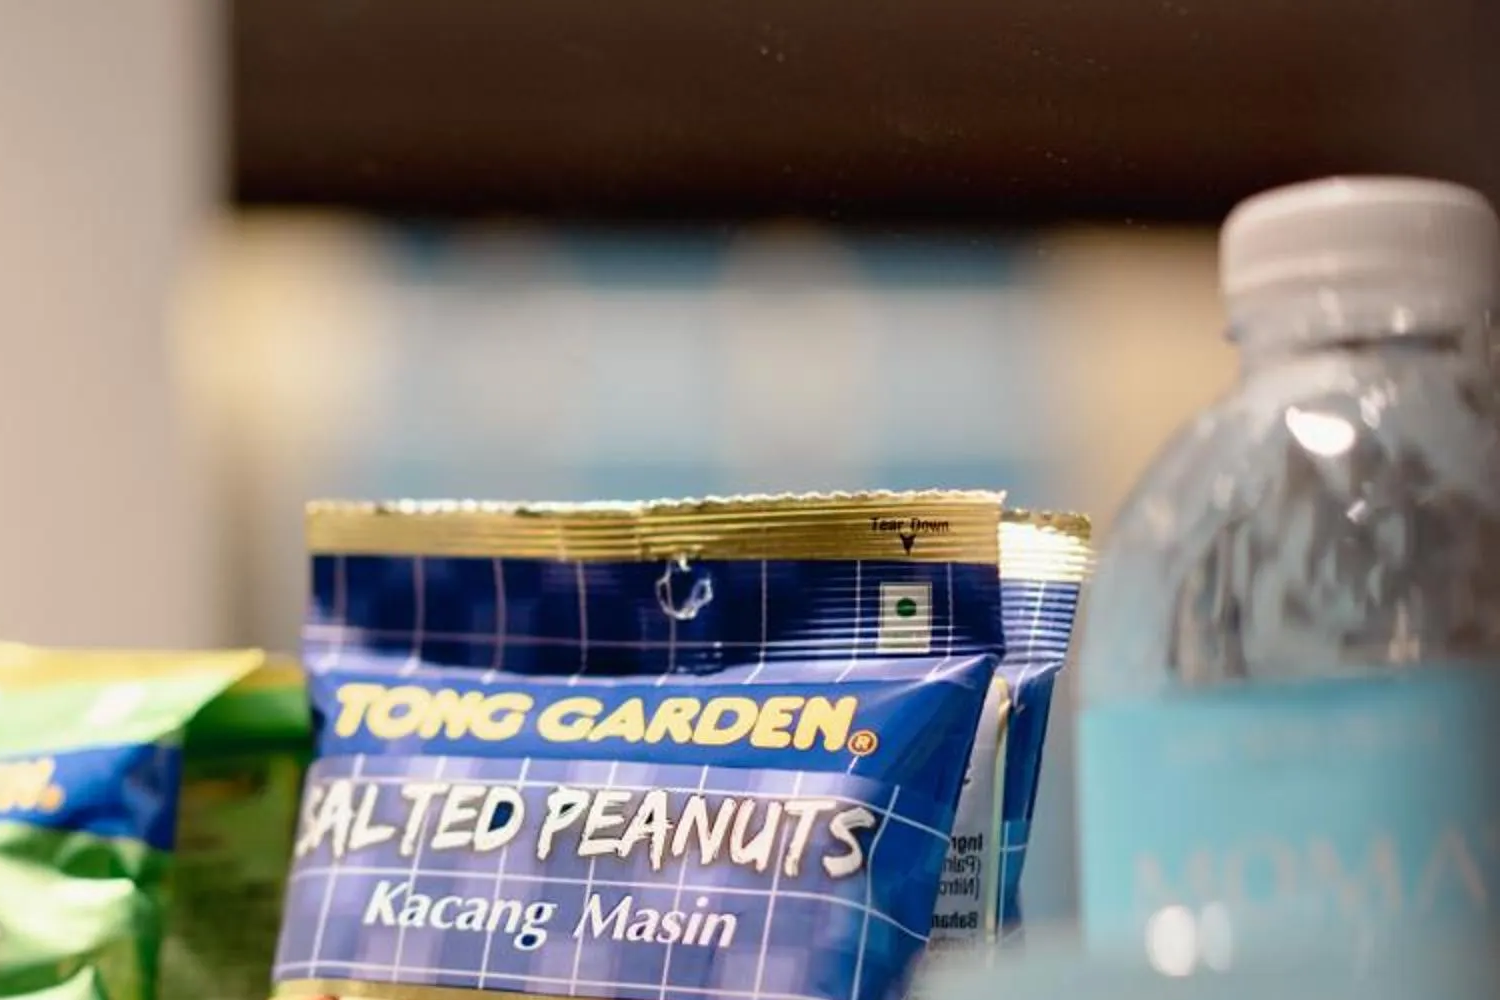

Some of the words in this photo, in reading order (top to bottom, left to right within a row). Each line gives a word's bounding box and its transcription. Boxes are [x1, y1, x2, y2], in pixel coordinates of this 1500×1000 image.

[869, 515, 904, 531] Tear
[910, 516, 949, 533] Down
[334, 682, 534, 741] TONG
[536, 695, 858, 752] GARDEN
[536, 784, 876, 879] PEANUTS
[362, 879, 559, 951] Kacang
[572, 893, 738, 948] Masin
